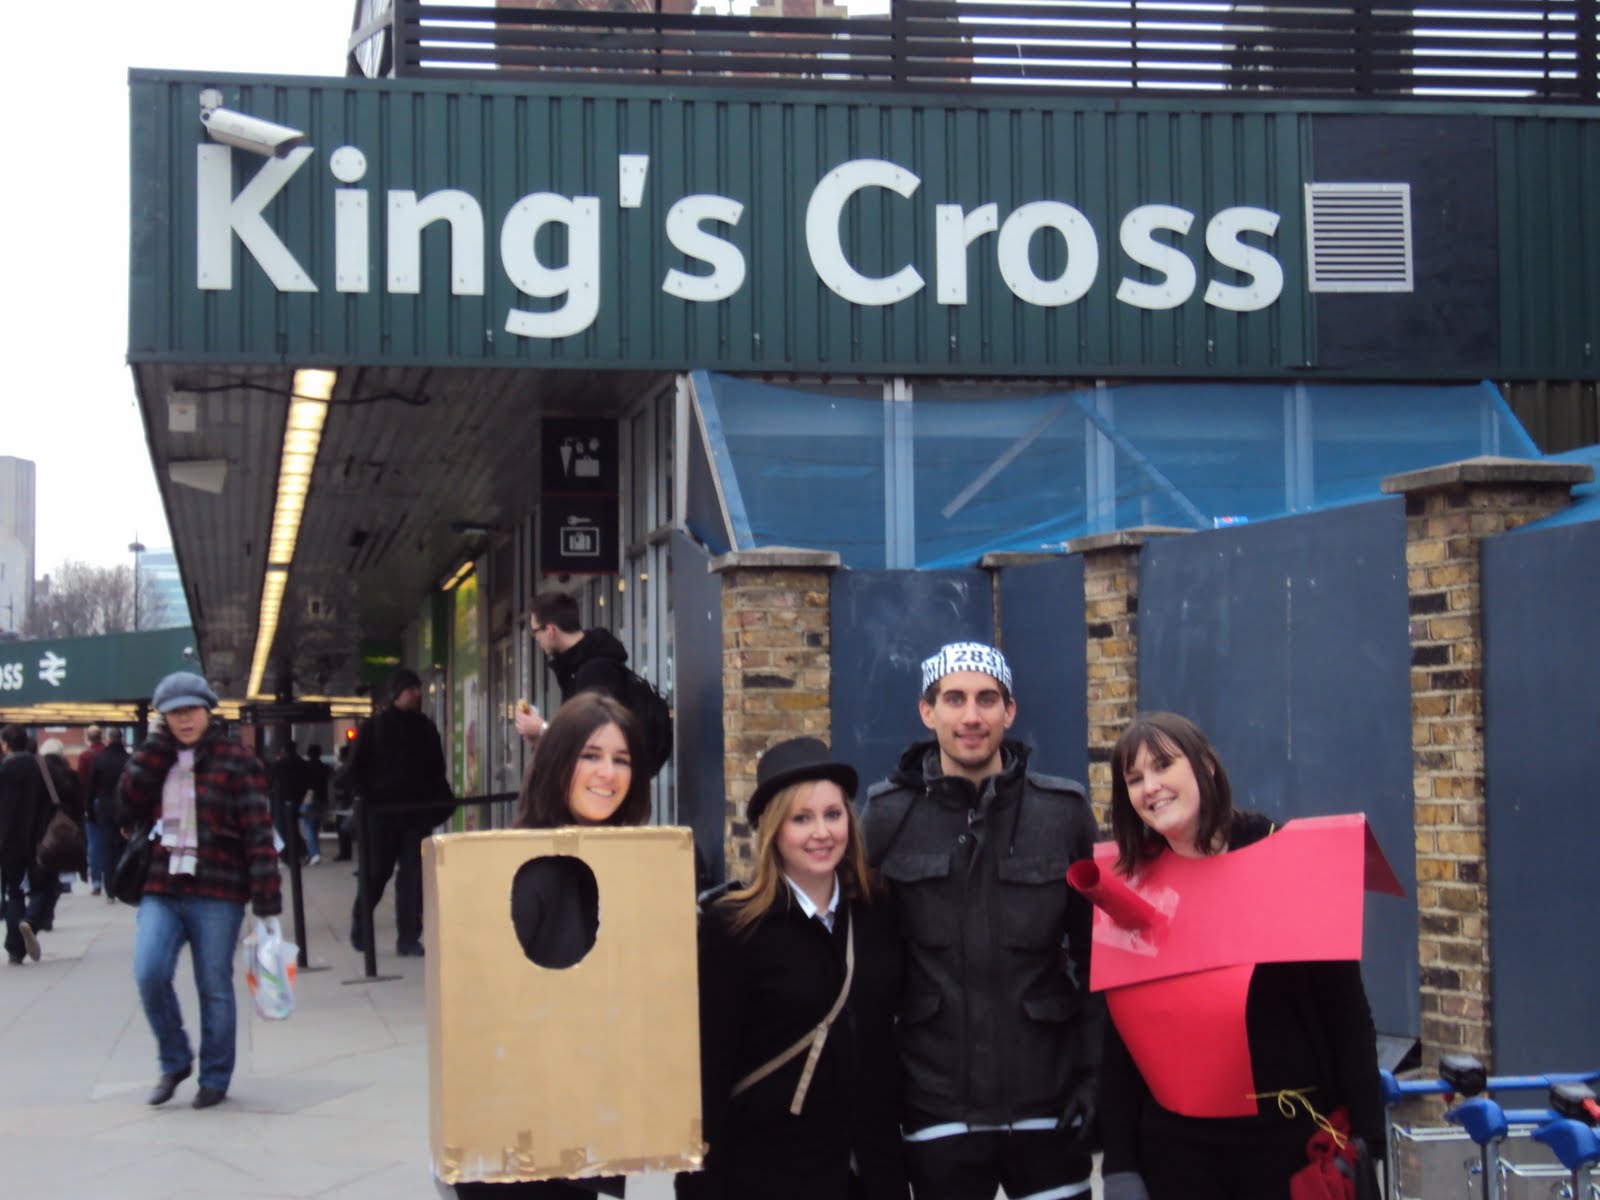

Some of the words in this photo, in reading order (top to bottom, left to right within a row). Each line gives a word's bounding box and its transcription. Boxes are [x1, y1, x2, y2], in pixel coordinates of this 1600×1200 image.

[197, 143, 746, 339] King's
[805, 158, 1284, 311] Cross
[0, 662, 23, 690] ss
